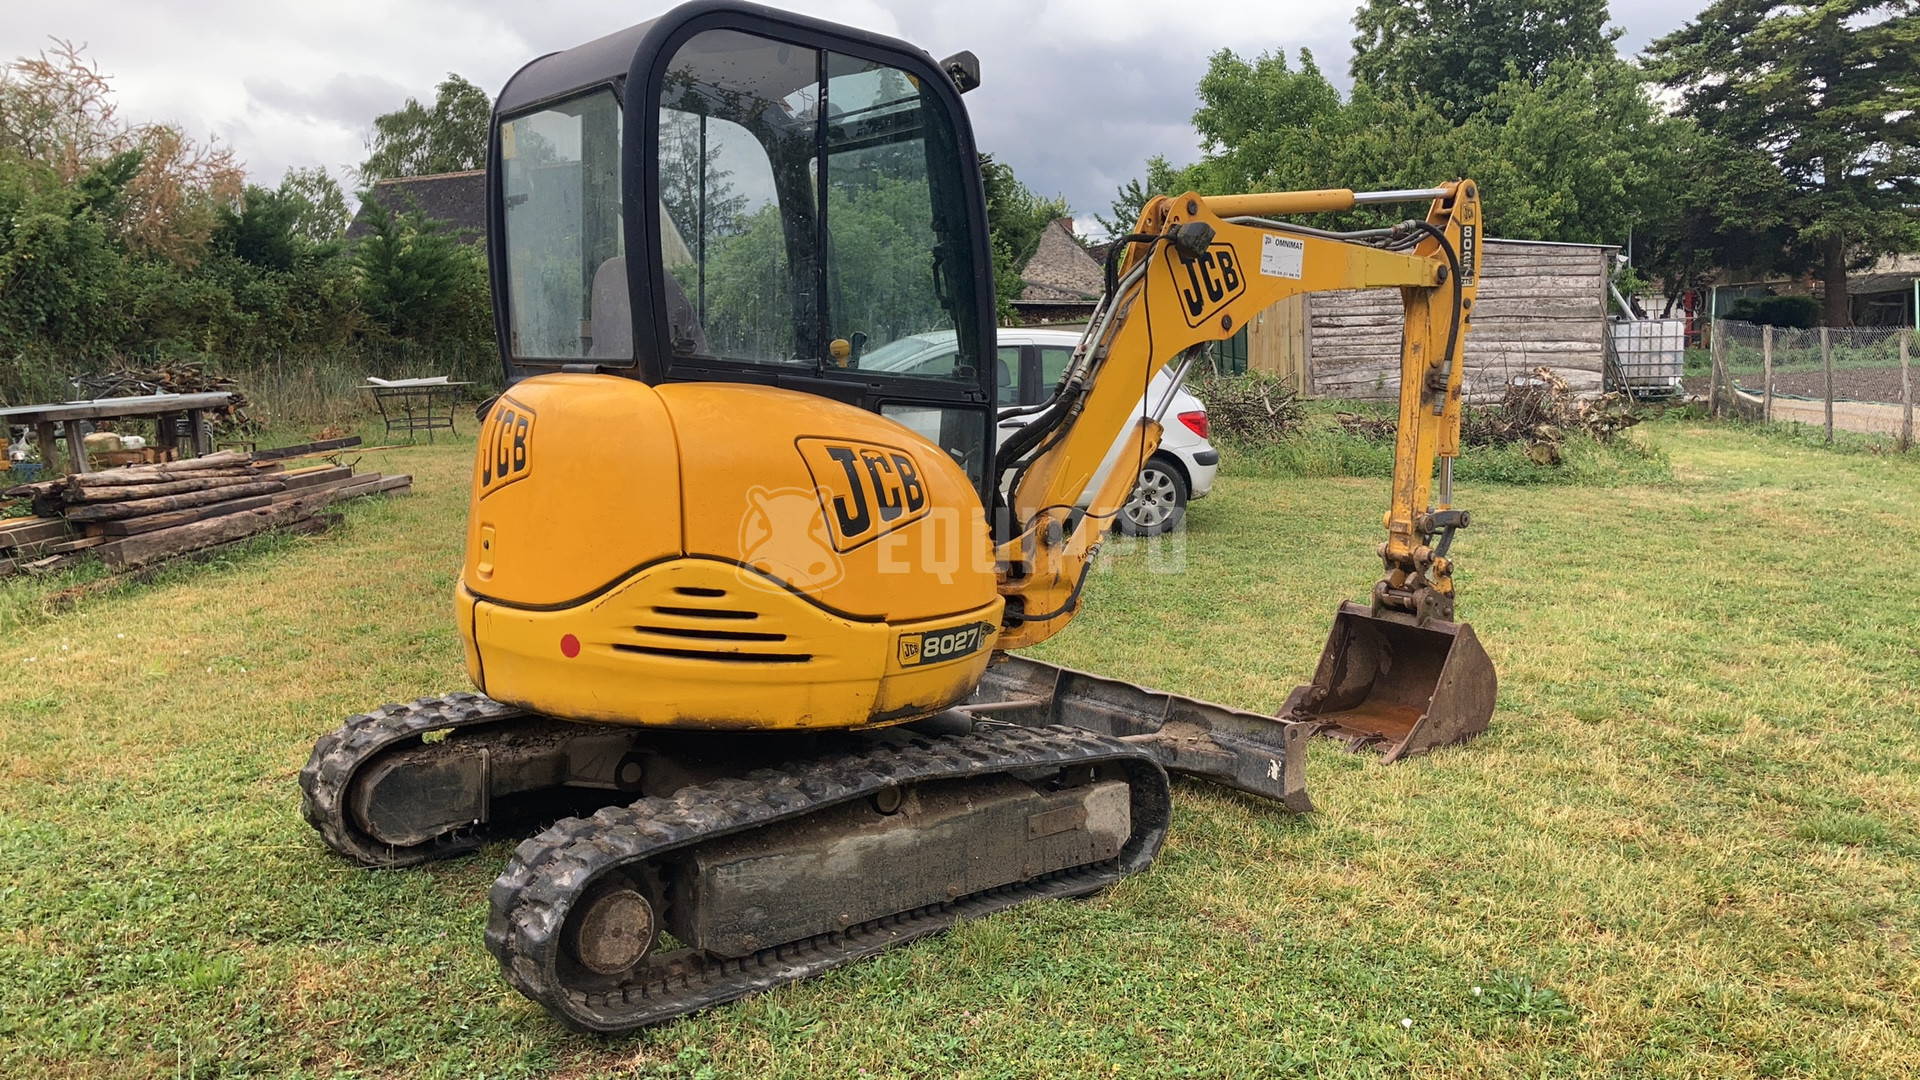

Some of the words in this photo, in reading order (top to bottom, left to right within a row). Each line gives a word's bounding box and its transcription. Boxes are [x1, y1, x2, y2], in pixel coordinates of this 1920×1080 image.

[1275, 239, 1302, 249] OMNIMAT
[1180, 251, 1239, 317] JCB
[482, 405, 529, 488] JCB
[825, 446, 925, 537] JCB
[904, 643, 919, 657] JCB
[923, 628, 979, 658] 8027
